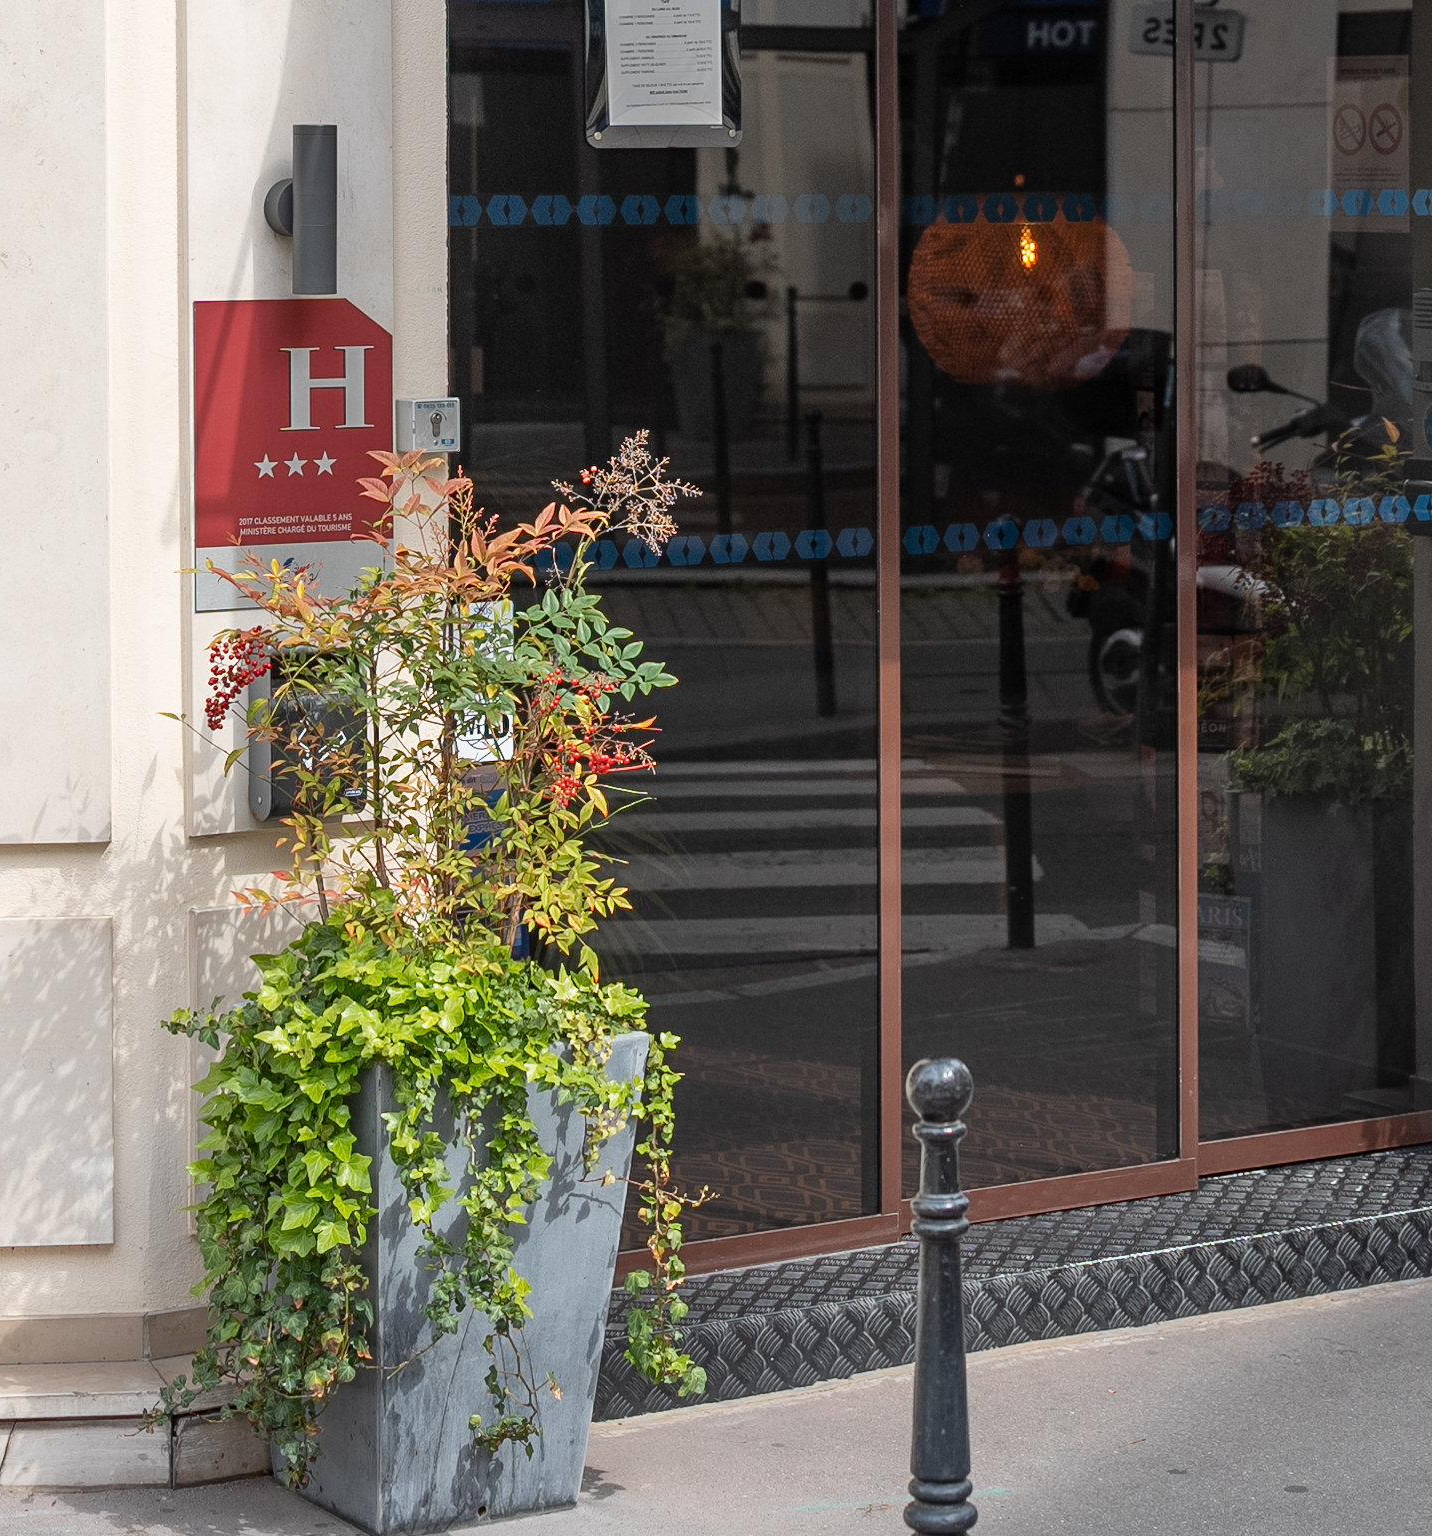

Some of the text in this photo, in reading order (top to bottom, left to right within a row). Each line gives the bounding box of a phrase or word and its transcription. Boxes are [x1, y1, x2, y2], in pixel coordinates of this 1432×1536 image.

[279, 346, 375, 431] H
[238, 512, 353, 526] 2017 CLASSEMENT VALABLE 5 ANS
[240, 523, 352, 536] MINISTÈRE CHARGÉ DU TOURISME
[1198, 719, 1227, 734] ÉON
